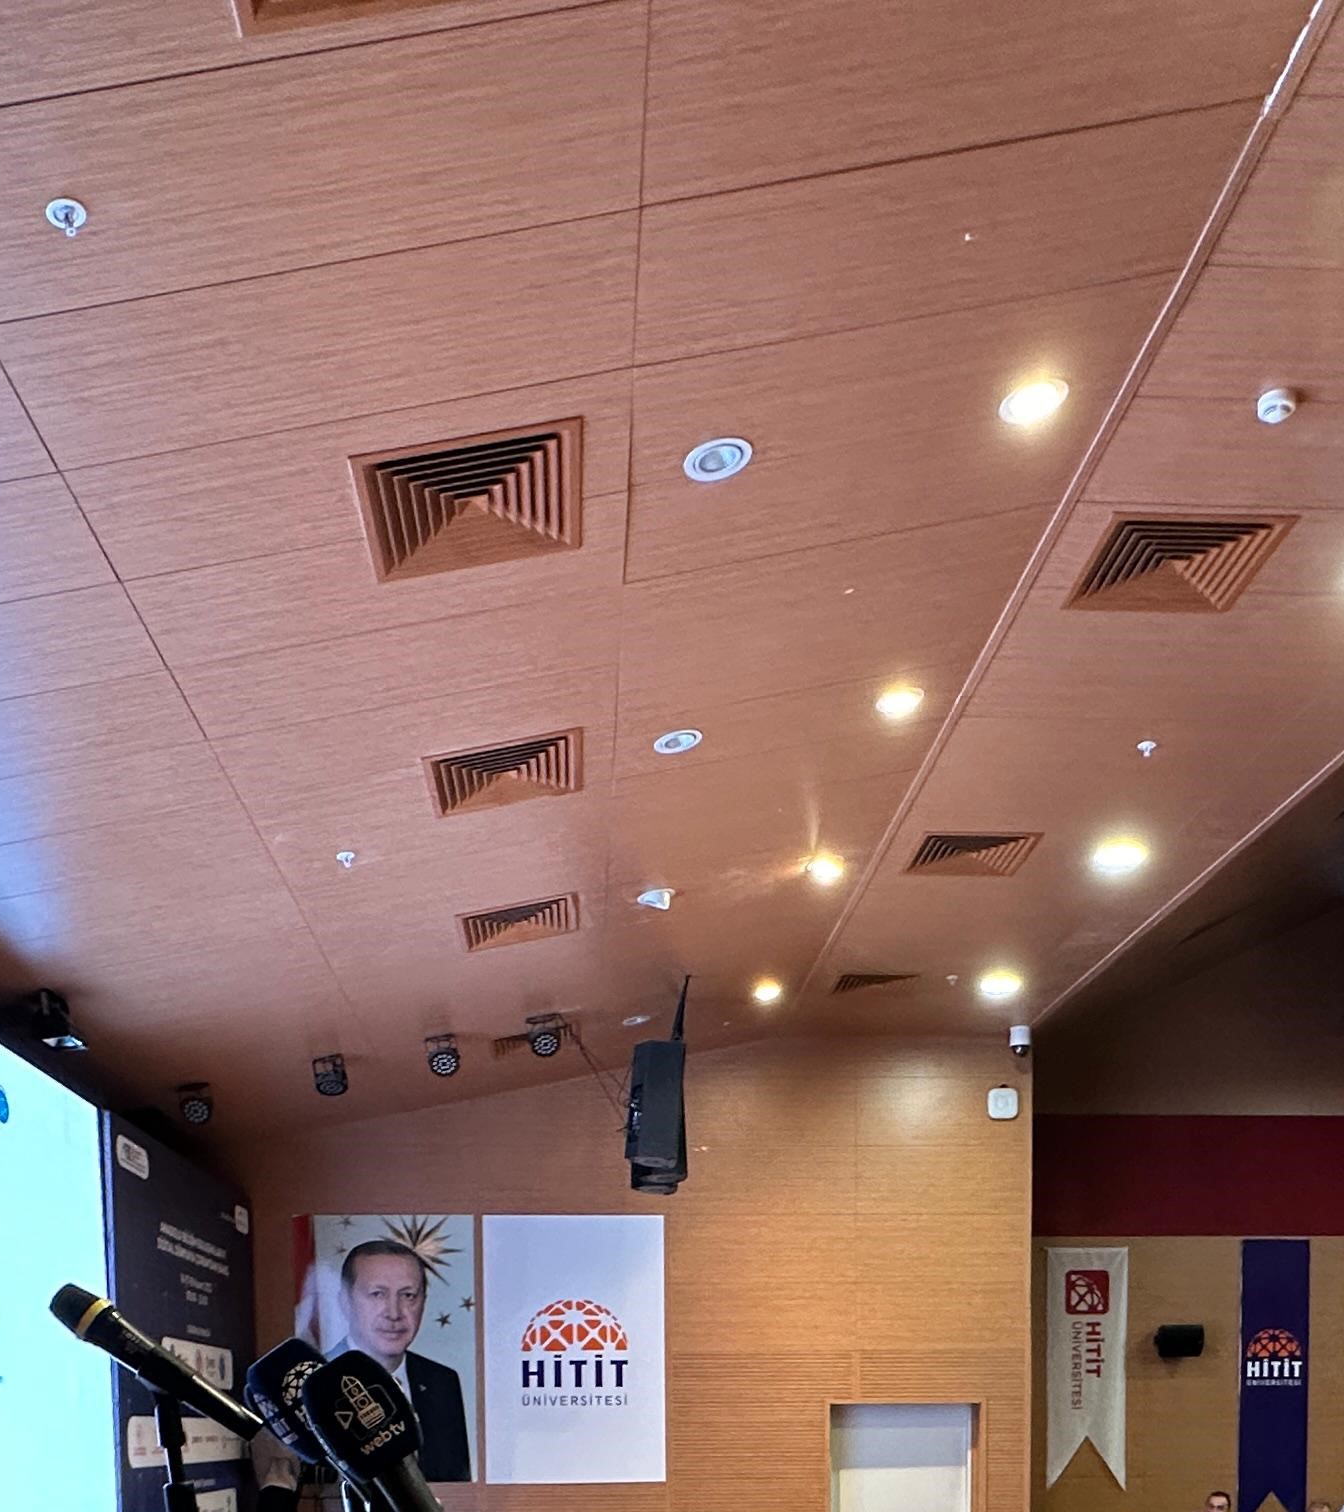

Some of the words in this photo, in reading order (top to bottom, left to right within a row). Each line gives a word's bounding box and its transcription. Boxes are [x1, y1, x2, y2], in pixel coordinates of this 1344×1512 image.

[1071, 1321, 1084, 1410] ÜNİVERSİTESİ
[1085, 1321, 1105, 1378] HİTİT
[522, 1354, 628, 1388] HİTİT
[1246, 1358, 1303, 1378] HİTİT
[521, 1393, 628, 1406] ÜNİVERSİTESİ
